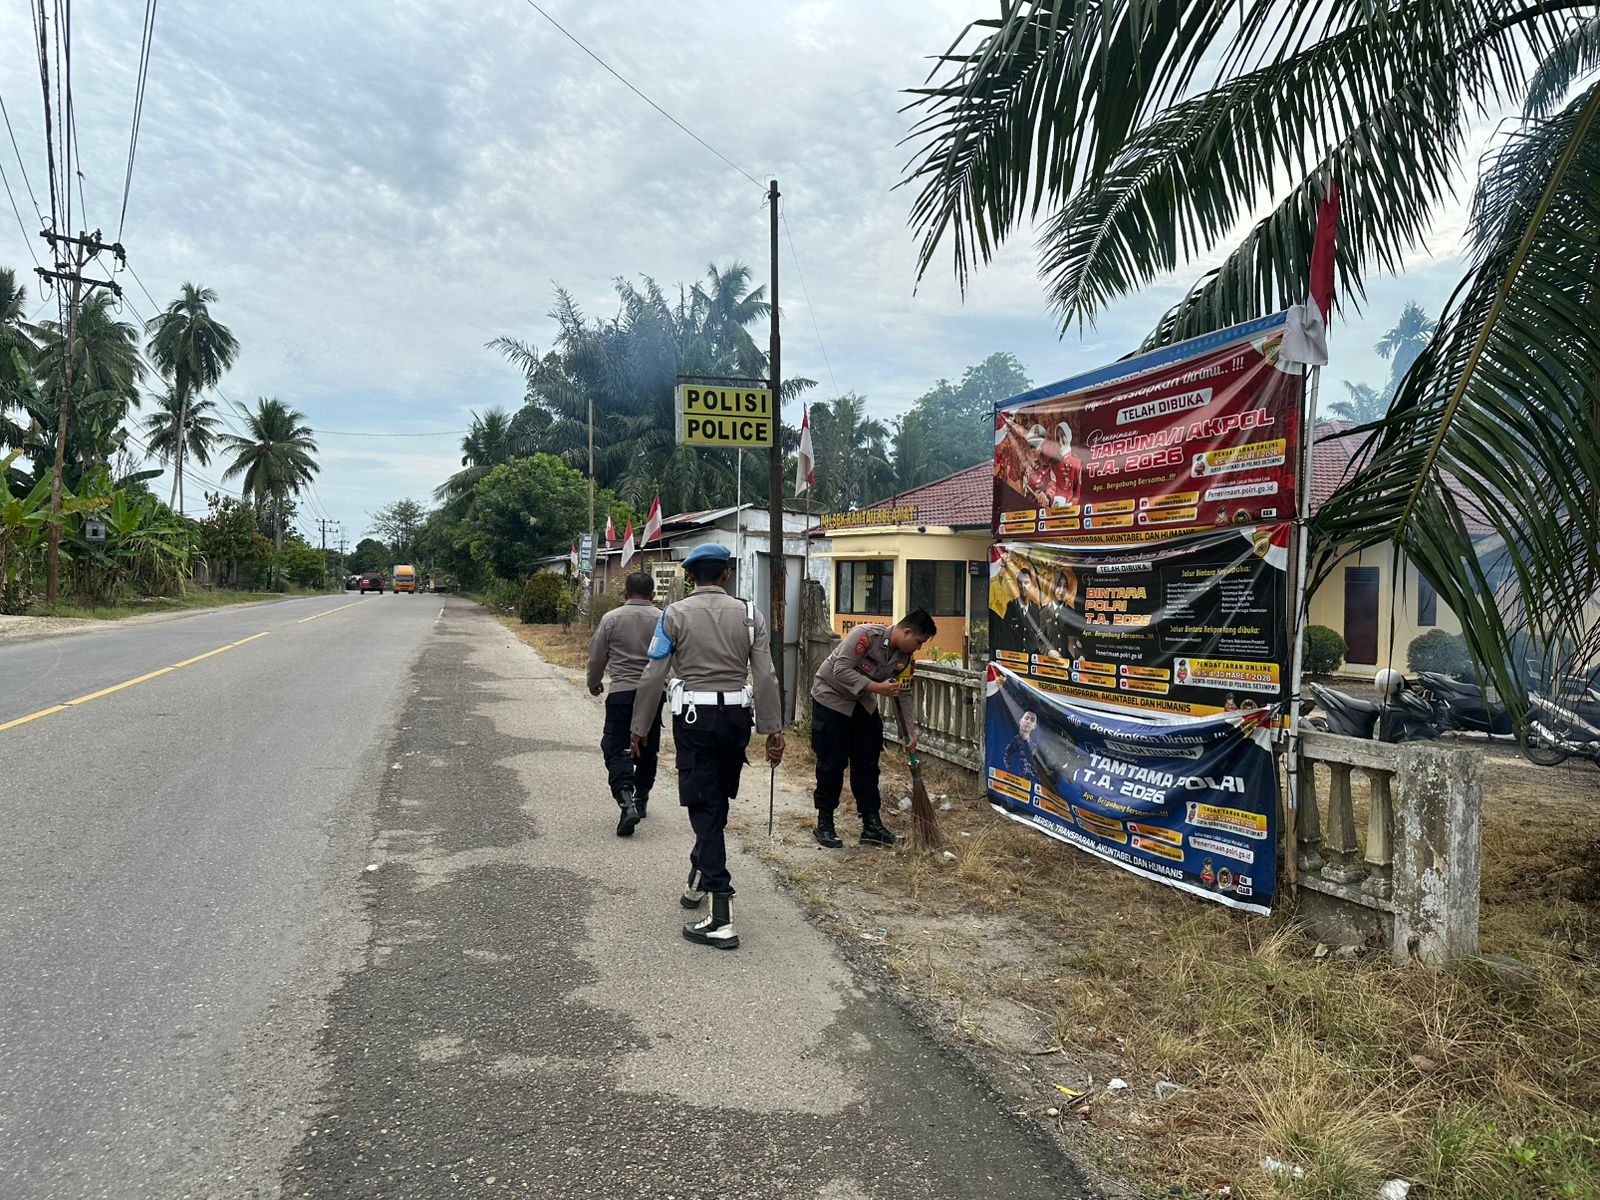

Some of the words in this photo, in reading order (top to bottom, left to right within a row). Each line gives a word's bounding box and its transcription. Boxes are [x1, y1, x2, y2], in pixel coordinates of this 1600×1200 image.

[687, 389, 766, 413] POLISI
[1122, 405, 1155, 421] TELAH
[1159, 393, 1205, 413] DIBUKA
[687, 419, 768, 442] POLICE
[1091, 426, 1184, 459] TARUNA/I
[1186, 408, 1275, 442] AKPOL
[1087, 459, 1119, 477] T.A.
[1125, 447, 1184, 472] 2026
[1208, 484, 1274, 498] Penerimaan.polri.go.id
[1106, 533, 1143, 542] AKUNTABEL
[1145, 531, 1159, 540] DAN
[1100, 565, 1119, 573] TELAH
[1121, 563, 1148, 572] DIBUKA
[1086, 587, 1147, 599] BINTARA
[1085, 600, 1127, 612] POLRI
[1085, 612, 1109, 624] T.A.
[1113, 613, 1152, 627] 2026
[1095, 649, 1143, 660] Penerimaan.polri.go.id
[1197, 661, 1243, 670] PENDAFTARAN
[1245, 664, 1272, 672] ONLINE
[1216, 670, 1225, 678] 30
[1226, 671, 1250, 680] MARET
[1251, 673, 1272, 682] 2026
[1059, 684, 1100, 700] TRANSPARAN,
[1101, 692, 1139, 706] AKUNTABEL
[1140, 698, 1155, 708] DAN
[1156, 700, 1191, 713] HUMANIS
[1089, 753, 1173, 789] TAMTAMA
[1173, 775, 1245, 794] POLRI
[1083, 768, 1113, 791] T.A.
[1120, 781, 1166, 804] 2026
[1055, 824, 1096, 849] TRANSPARAN,
[1097, 842, 1133, 864] AKUNTABEL
[1133, 856, 1148, 869] DAN
[1148, 860, 1184, 880] HUMANIS
